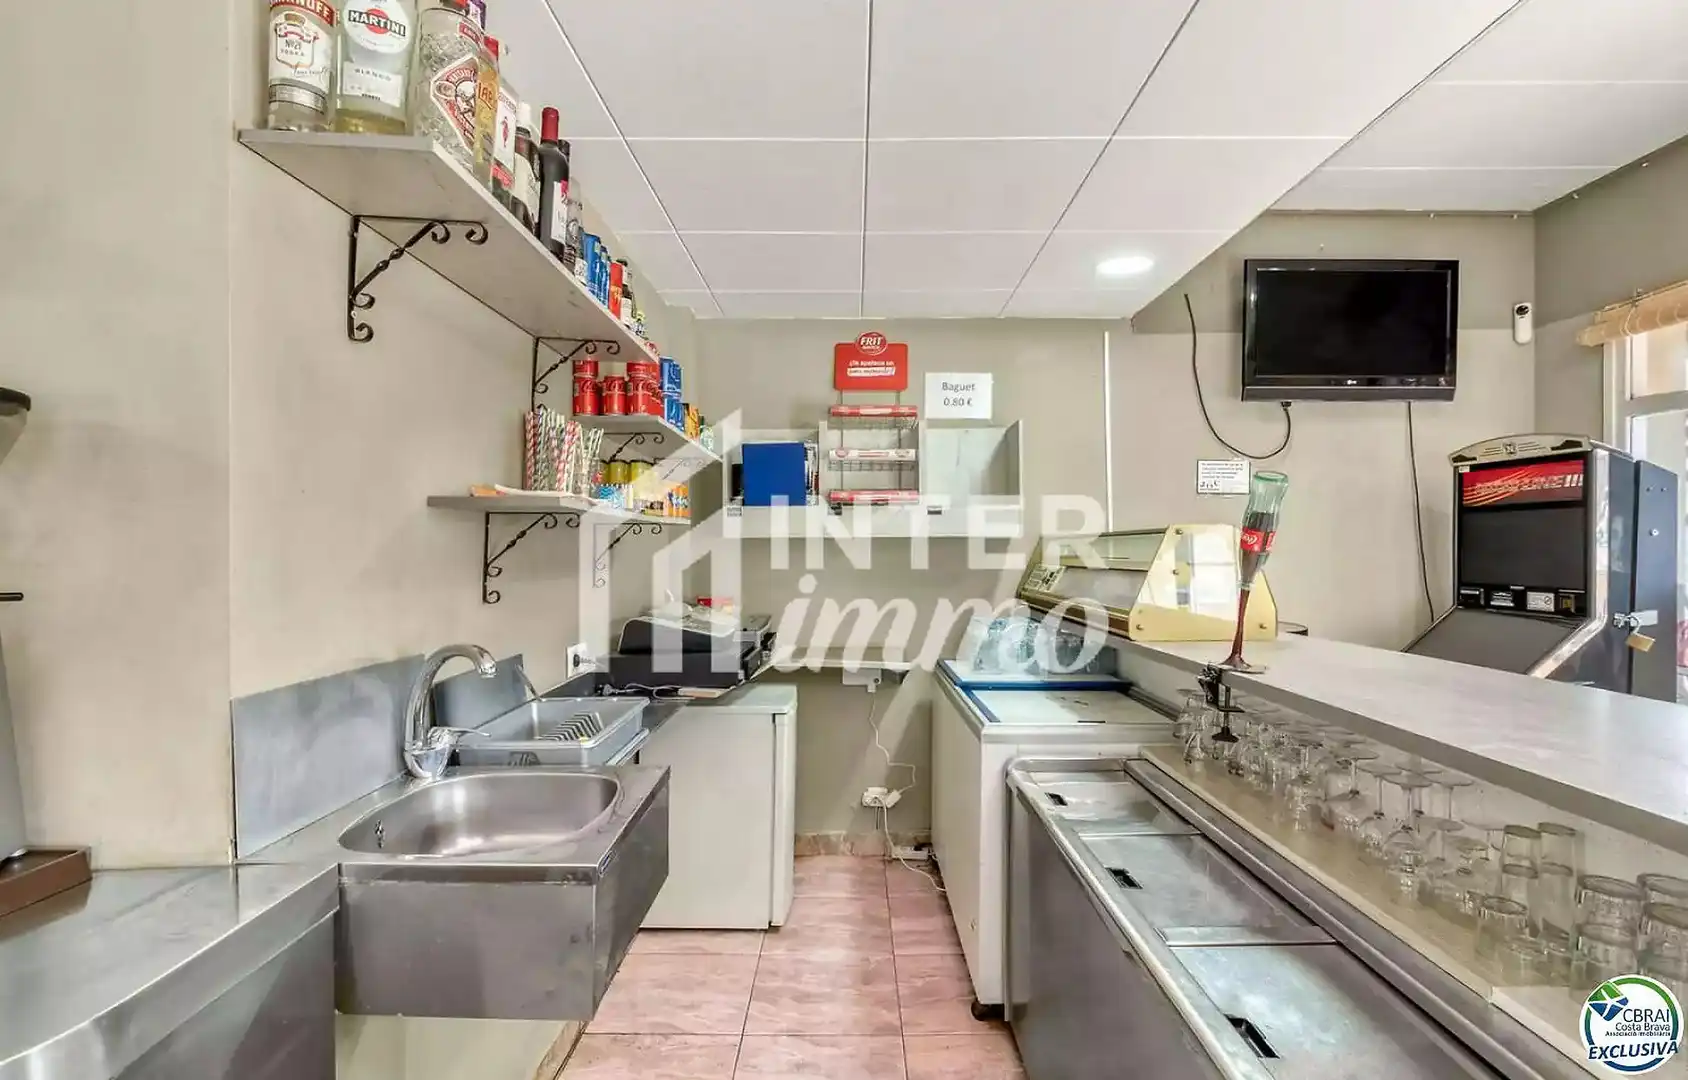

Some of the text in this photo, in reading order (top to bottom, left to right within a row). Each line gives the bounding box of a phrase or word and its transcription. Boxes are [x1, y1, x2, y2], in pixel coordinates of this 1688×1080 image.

[348, 10, 406, 37] MARTINI
[860, 336, 883, 347] FRIT
[942, 381, 976, 393] Baguet
